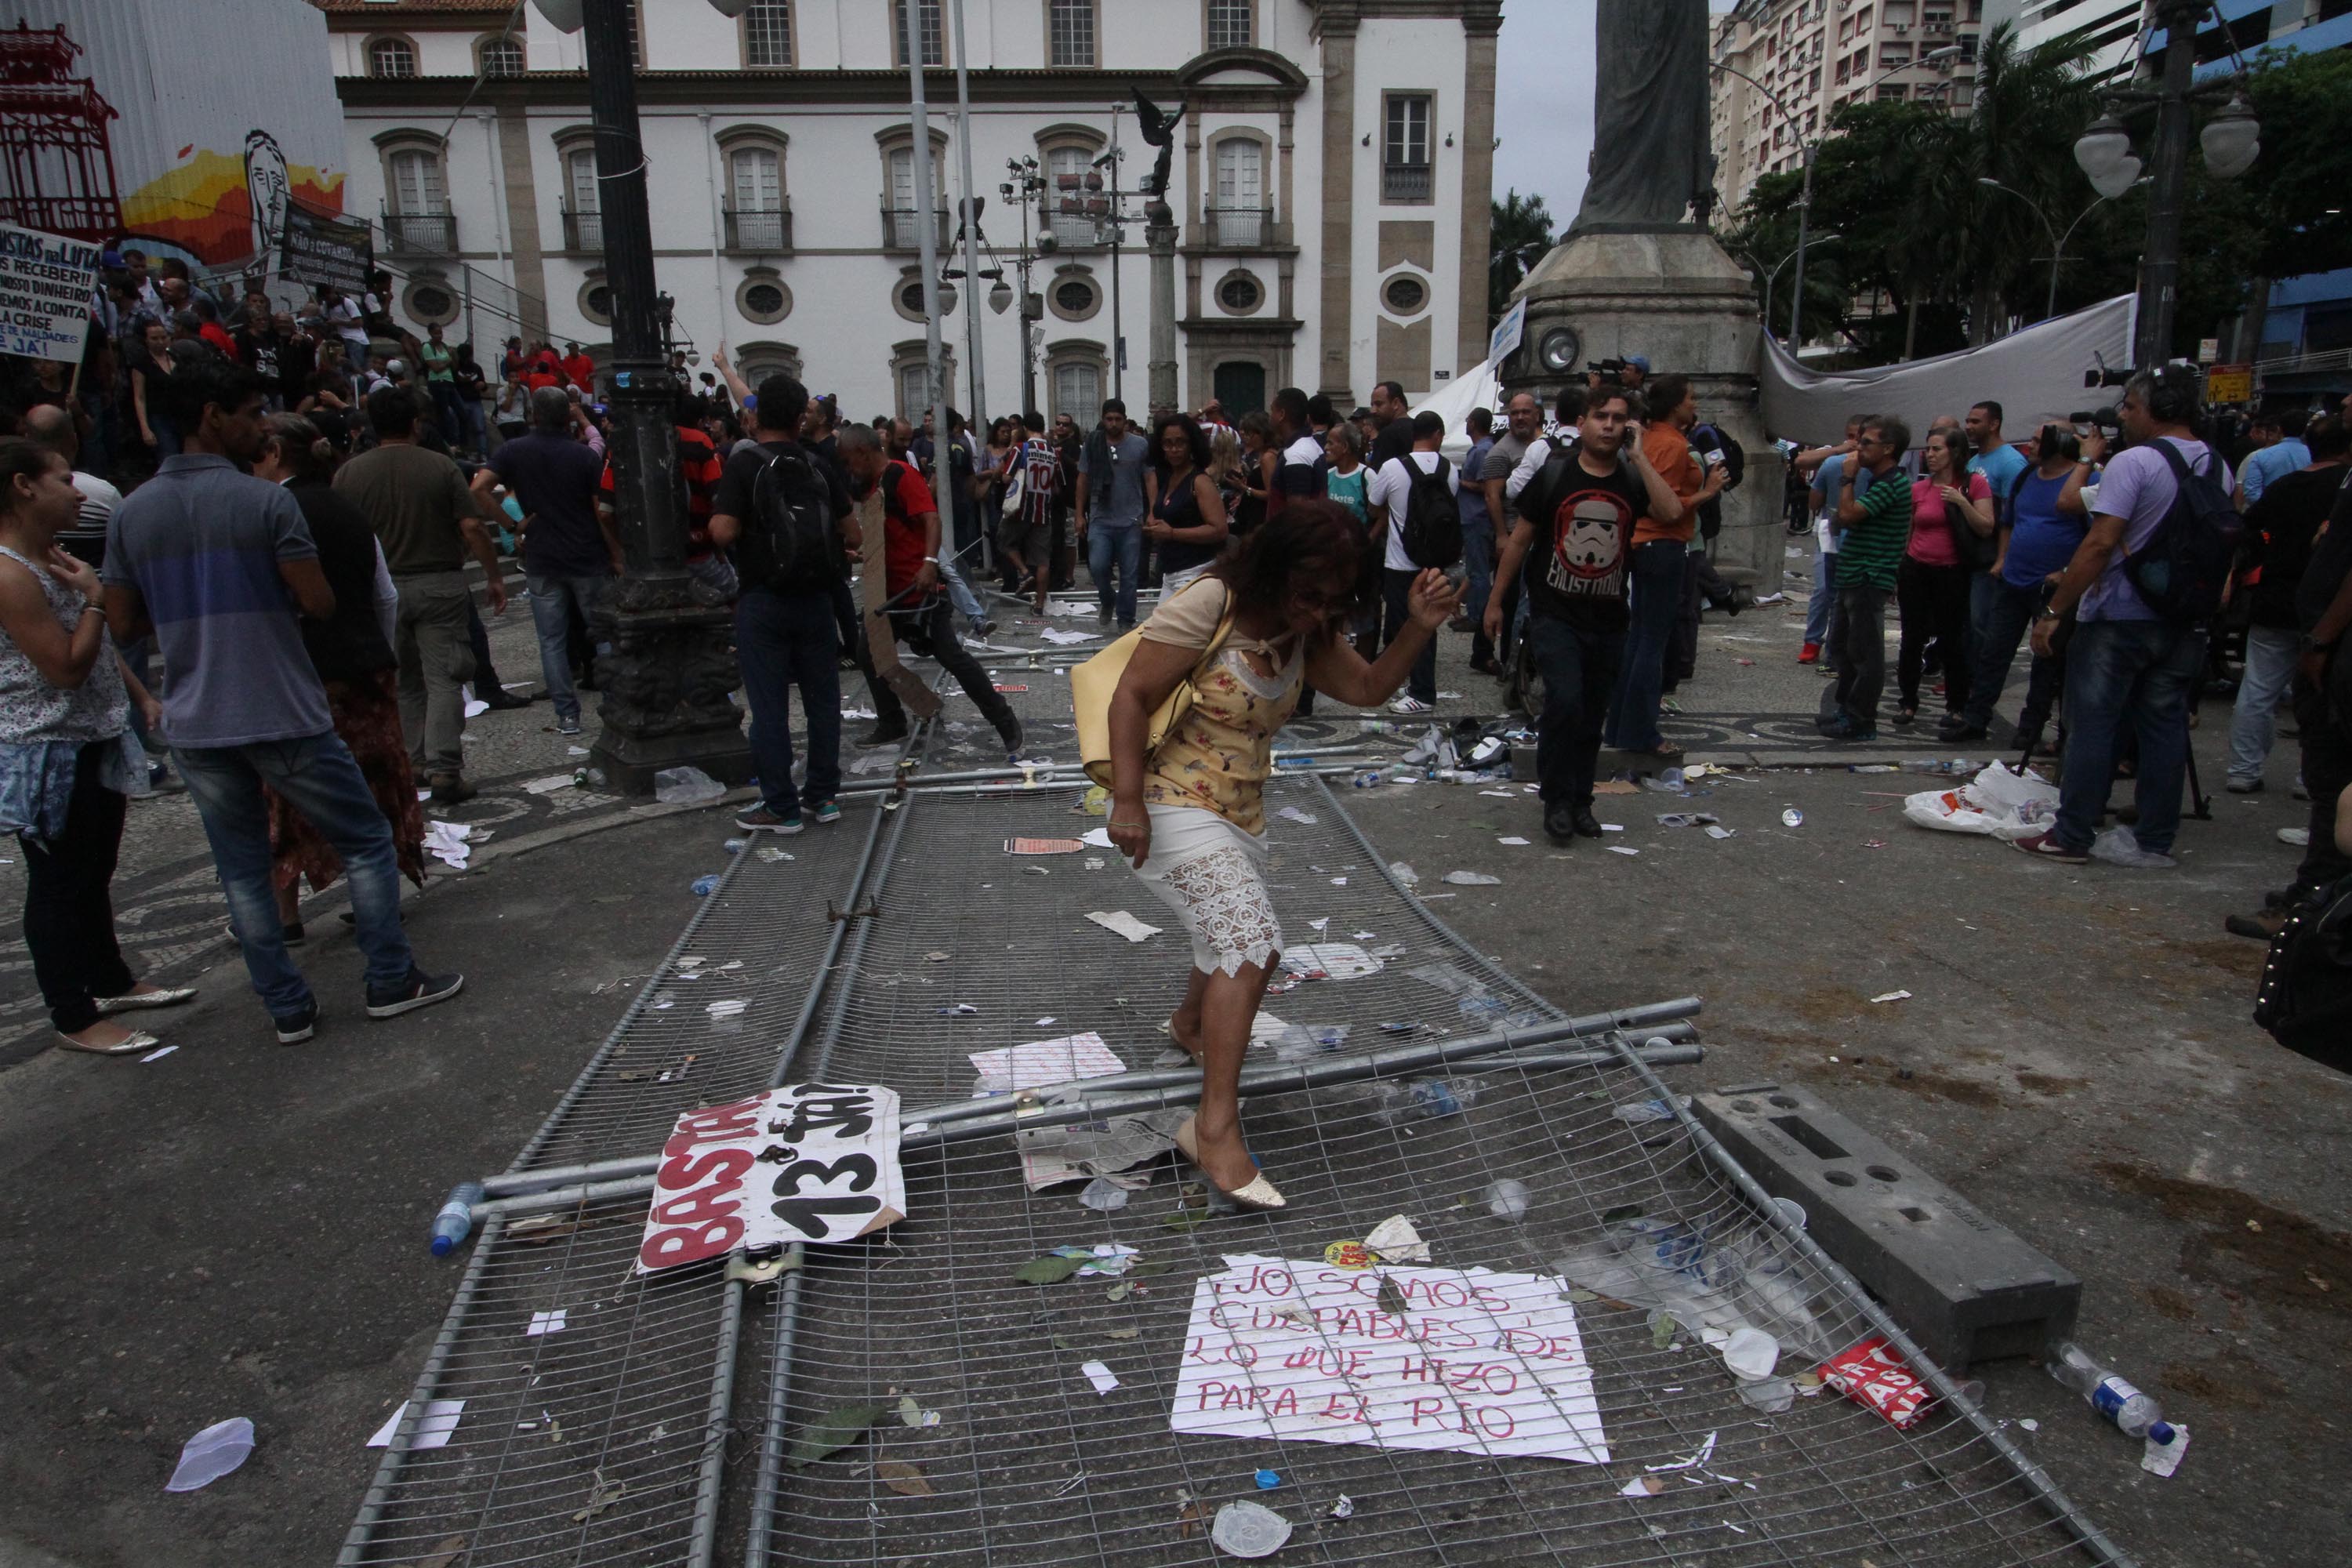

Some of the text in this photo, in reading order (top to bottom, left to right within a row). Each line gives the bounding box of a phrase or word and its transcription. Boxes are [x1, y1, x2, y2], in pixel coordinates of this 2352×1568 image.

[14, 313, 53, 331] CRISE
[1029, 463, 1051, 490] 10
[640, 1091, 772, 1269] BASTA!
[1198, 1381, 1299, 1417] PARA
[1403, 1396, 1515, 1439] RIO
